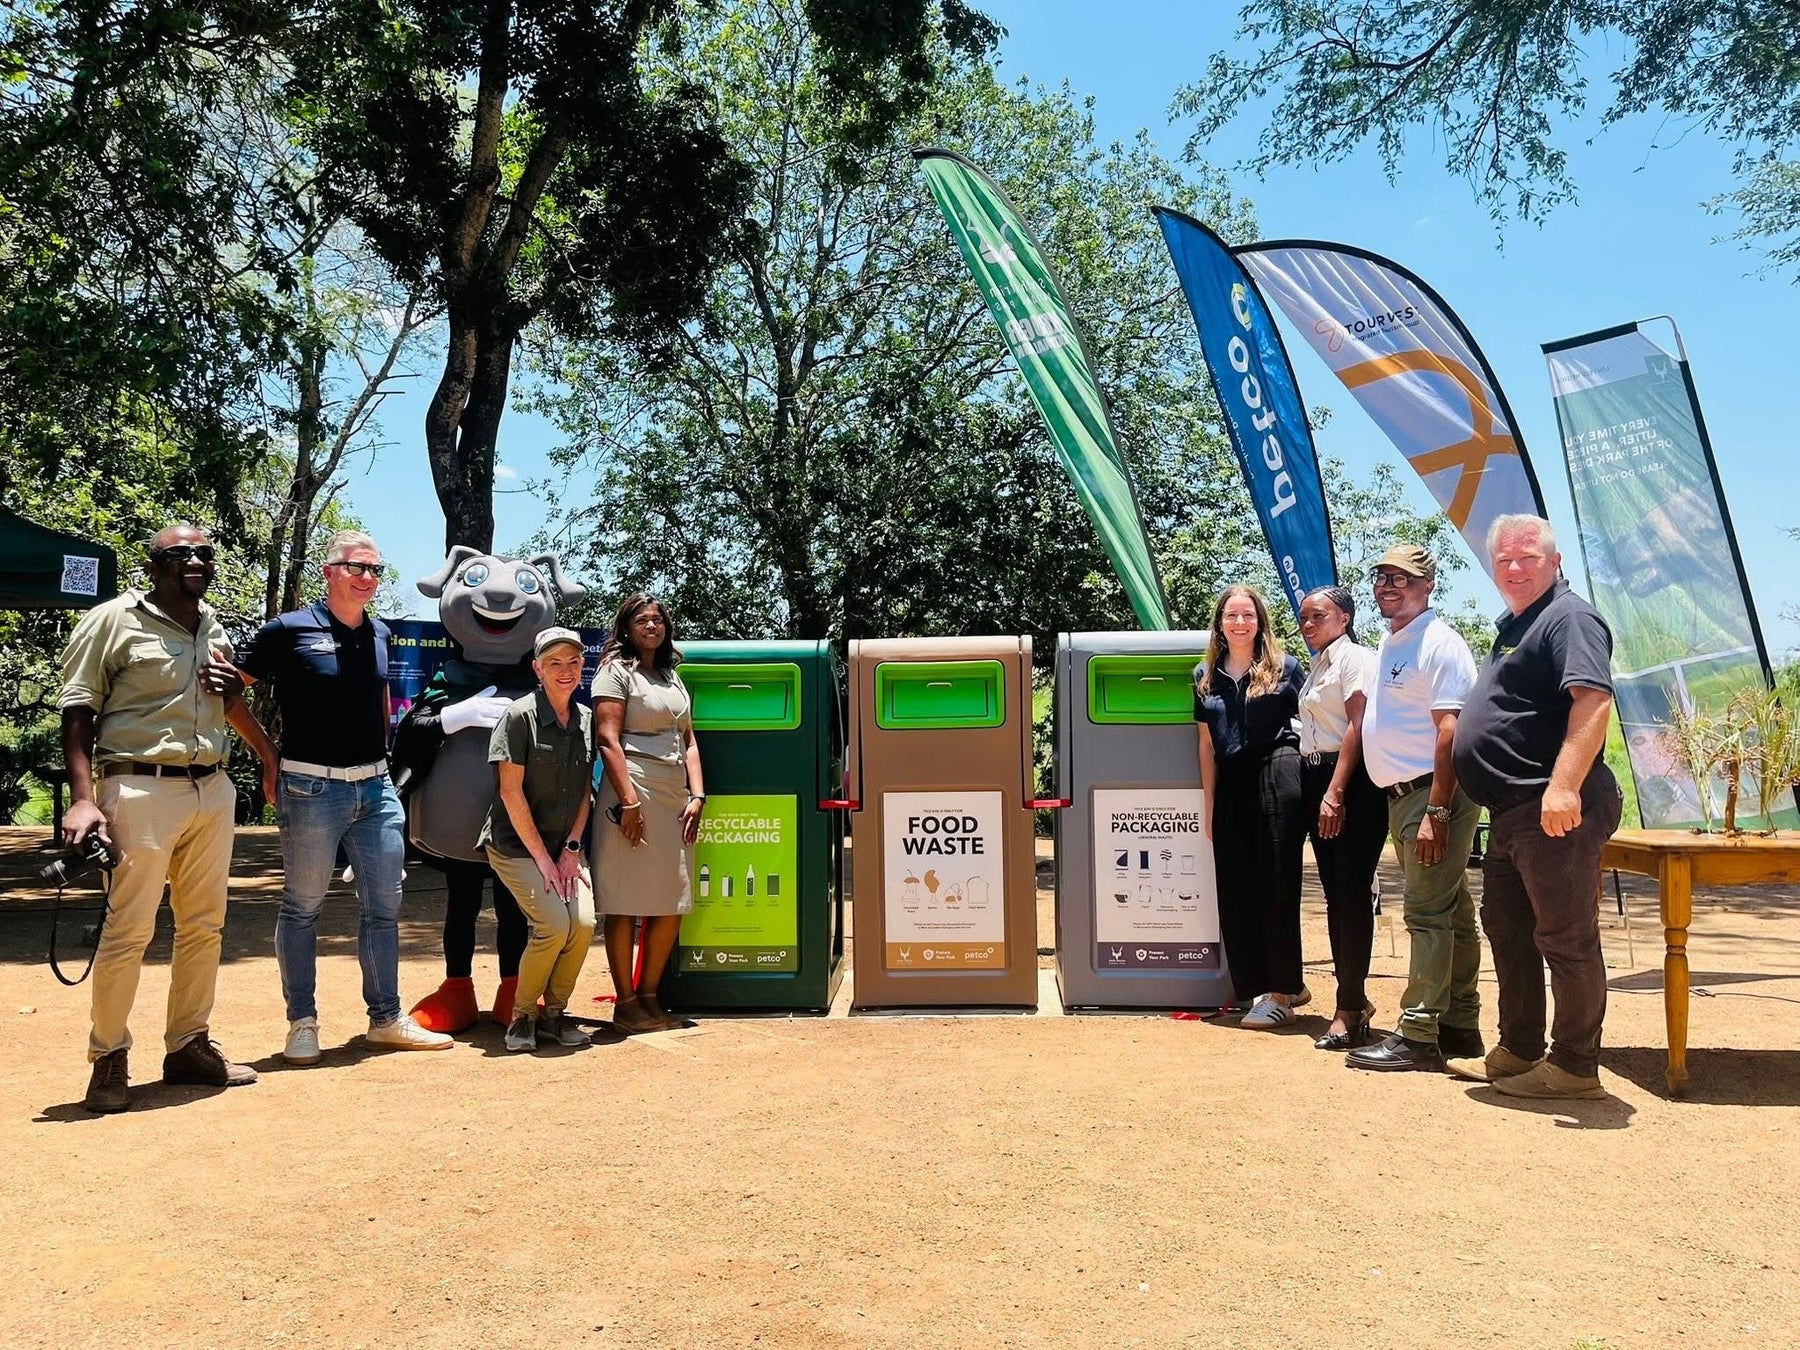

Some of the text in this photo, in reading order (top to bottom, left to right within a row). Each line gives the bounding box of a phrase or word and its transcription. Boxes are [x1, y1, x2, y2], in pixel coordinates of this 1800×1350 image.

[419, 637, 447, 648] and
[1111, 812, 1199, 821] NON-RECYCLABLE
[698, 818, 781, 830] RECYCLABLE
[908, 815, 978, 834] FOOD
[1111, 822, 1199, 833] PACKAGING
[696, 831, 781, 844] PACKAGING
[902, 837, 985, 855] WASTE
[757, 954, 781, 963] petco
[964, 951, 989, 960] petco
[1178, 951, 1204, 961] petco
